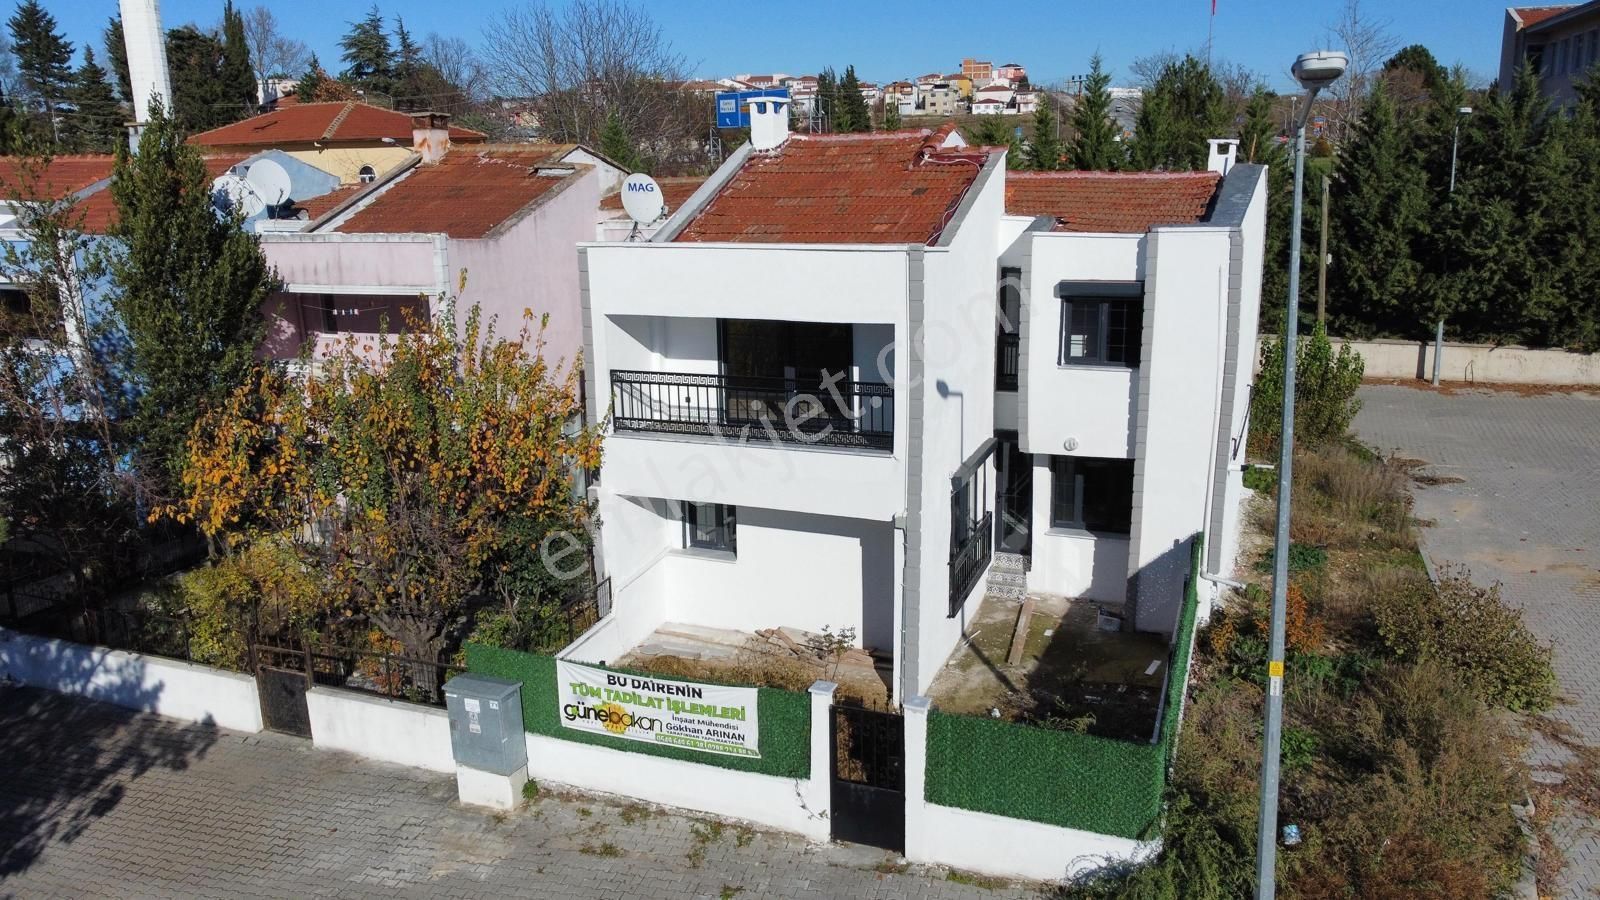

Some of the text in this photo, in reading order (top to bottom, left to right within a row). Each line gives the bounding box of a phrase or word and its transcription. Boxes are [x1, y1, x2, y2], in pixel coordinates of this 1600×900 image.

[628, 182, 654, 192] MAG
[606, 674, 703, 699] BU DAİRENİN
[569, 682, 746, 721] TÜM TADİLAT İŞLEMLERİ
[563, 701, 663, 732] günebakan
[672, 713, 739, 731] İnşaat Mühendisi
[665, 722, 703, 735] Gökhan
[705, 728, 745, 741] ARINAN
